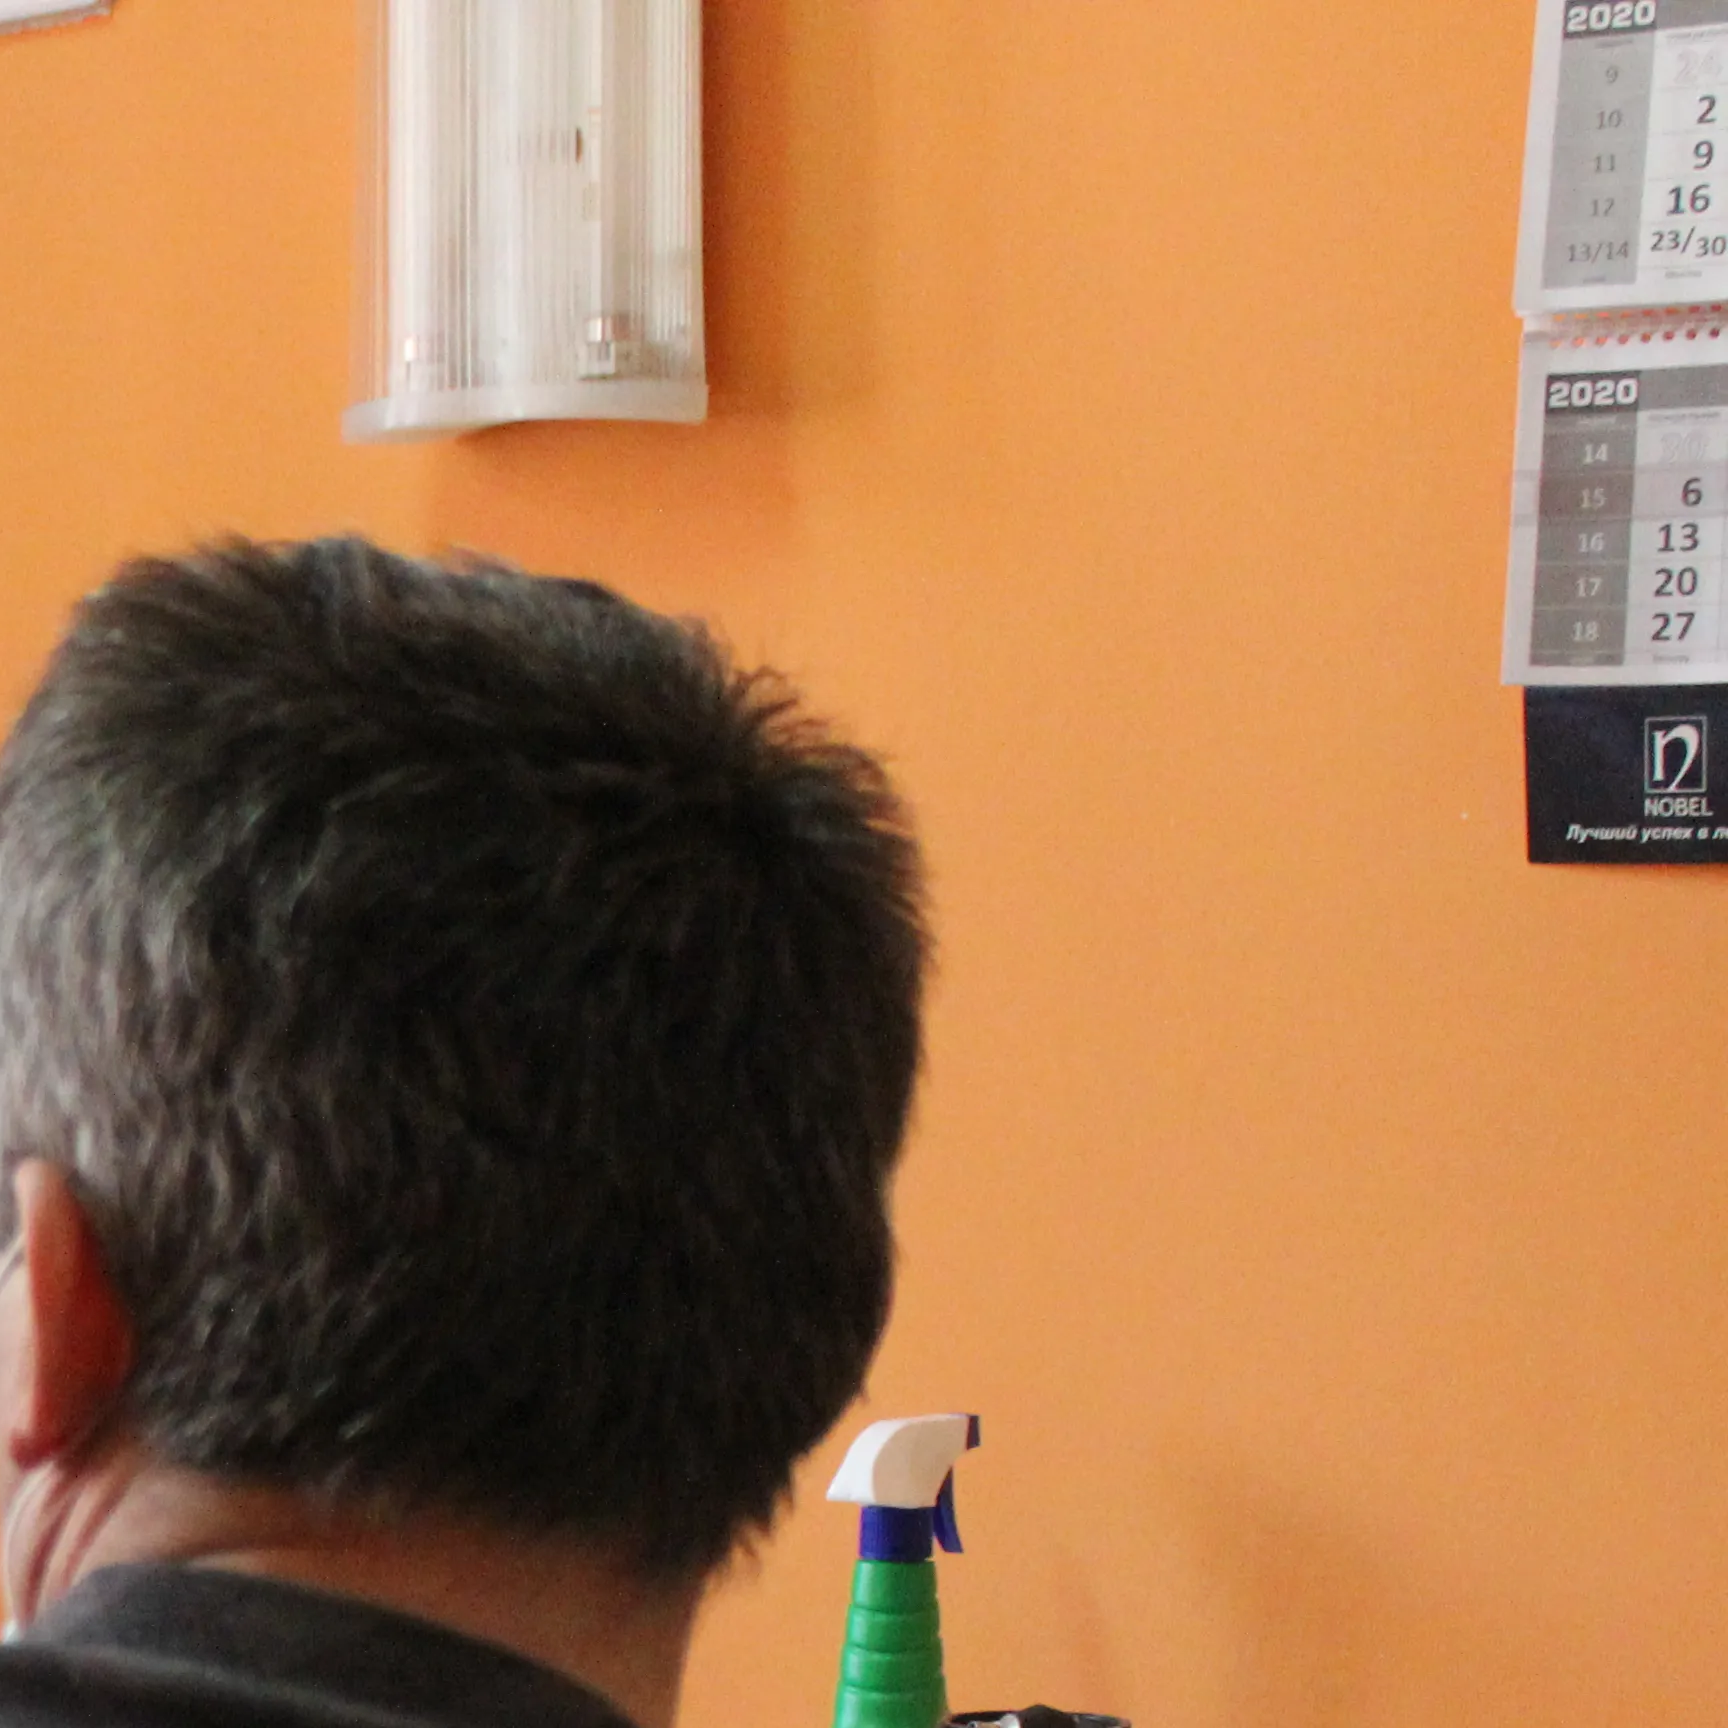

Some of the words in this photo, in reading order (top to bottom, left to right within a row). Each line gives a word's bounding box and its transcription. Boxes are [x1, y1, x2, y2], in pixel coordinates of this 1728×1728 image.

[1566, 1, 1656, 33] 2020
[1596, 109, 1623, 130] 10
[1696, 94, 1717, 125] 2
[1595, 153, 1617, 173] 11
[1693, 139, 1714, 170] 9
[1666, 183, 1711, 217] 16
[1650, 225, 1727, 259] 23/30
[1549, 376, 1638, 410] 2020
[1582, 442, 1609, 466] 14
[1580, 487, 1606, 509] 15
[1681, 477, 1703, 507] 6
[1577, 531, 1605, 553] 16
[1657, 522, 1700, 553] 13
[1575, 576, 1603, 598] 17
[1654, 566, 1698, 598] 20
[1572, 620, 1599, 643] 18
[1651, 611, 1696, 642] 27
[1645, 797, 1714, 818] NOBEL
[1566, 823, 1638, 844] Лучший
[1641, 825, 1694, 844] успех
